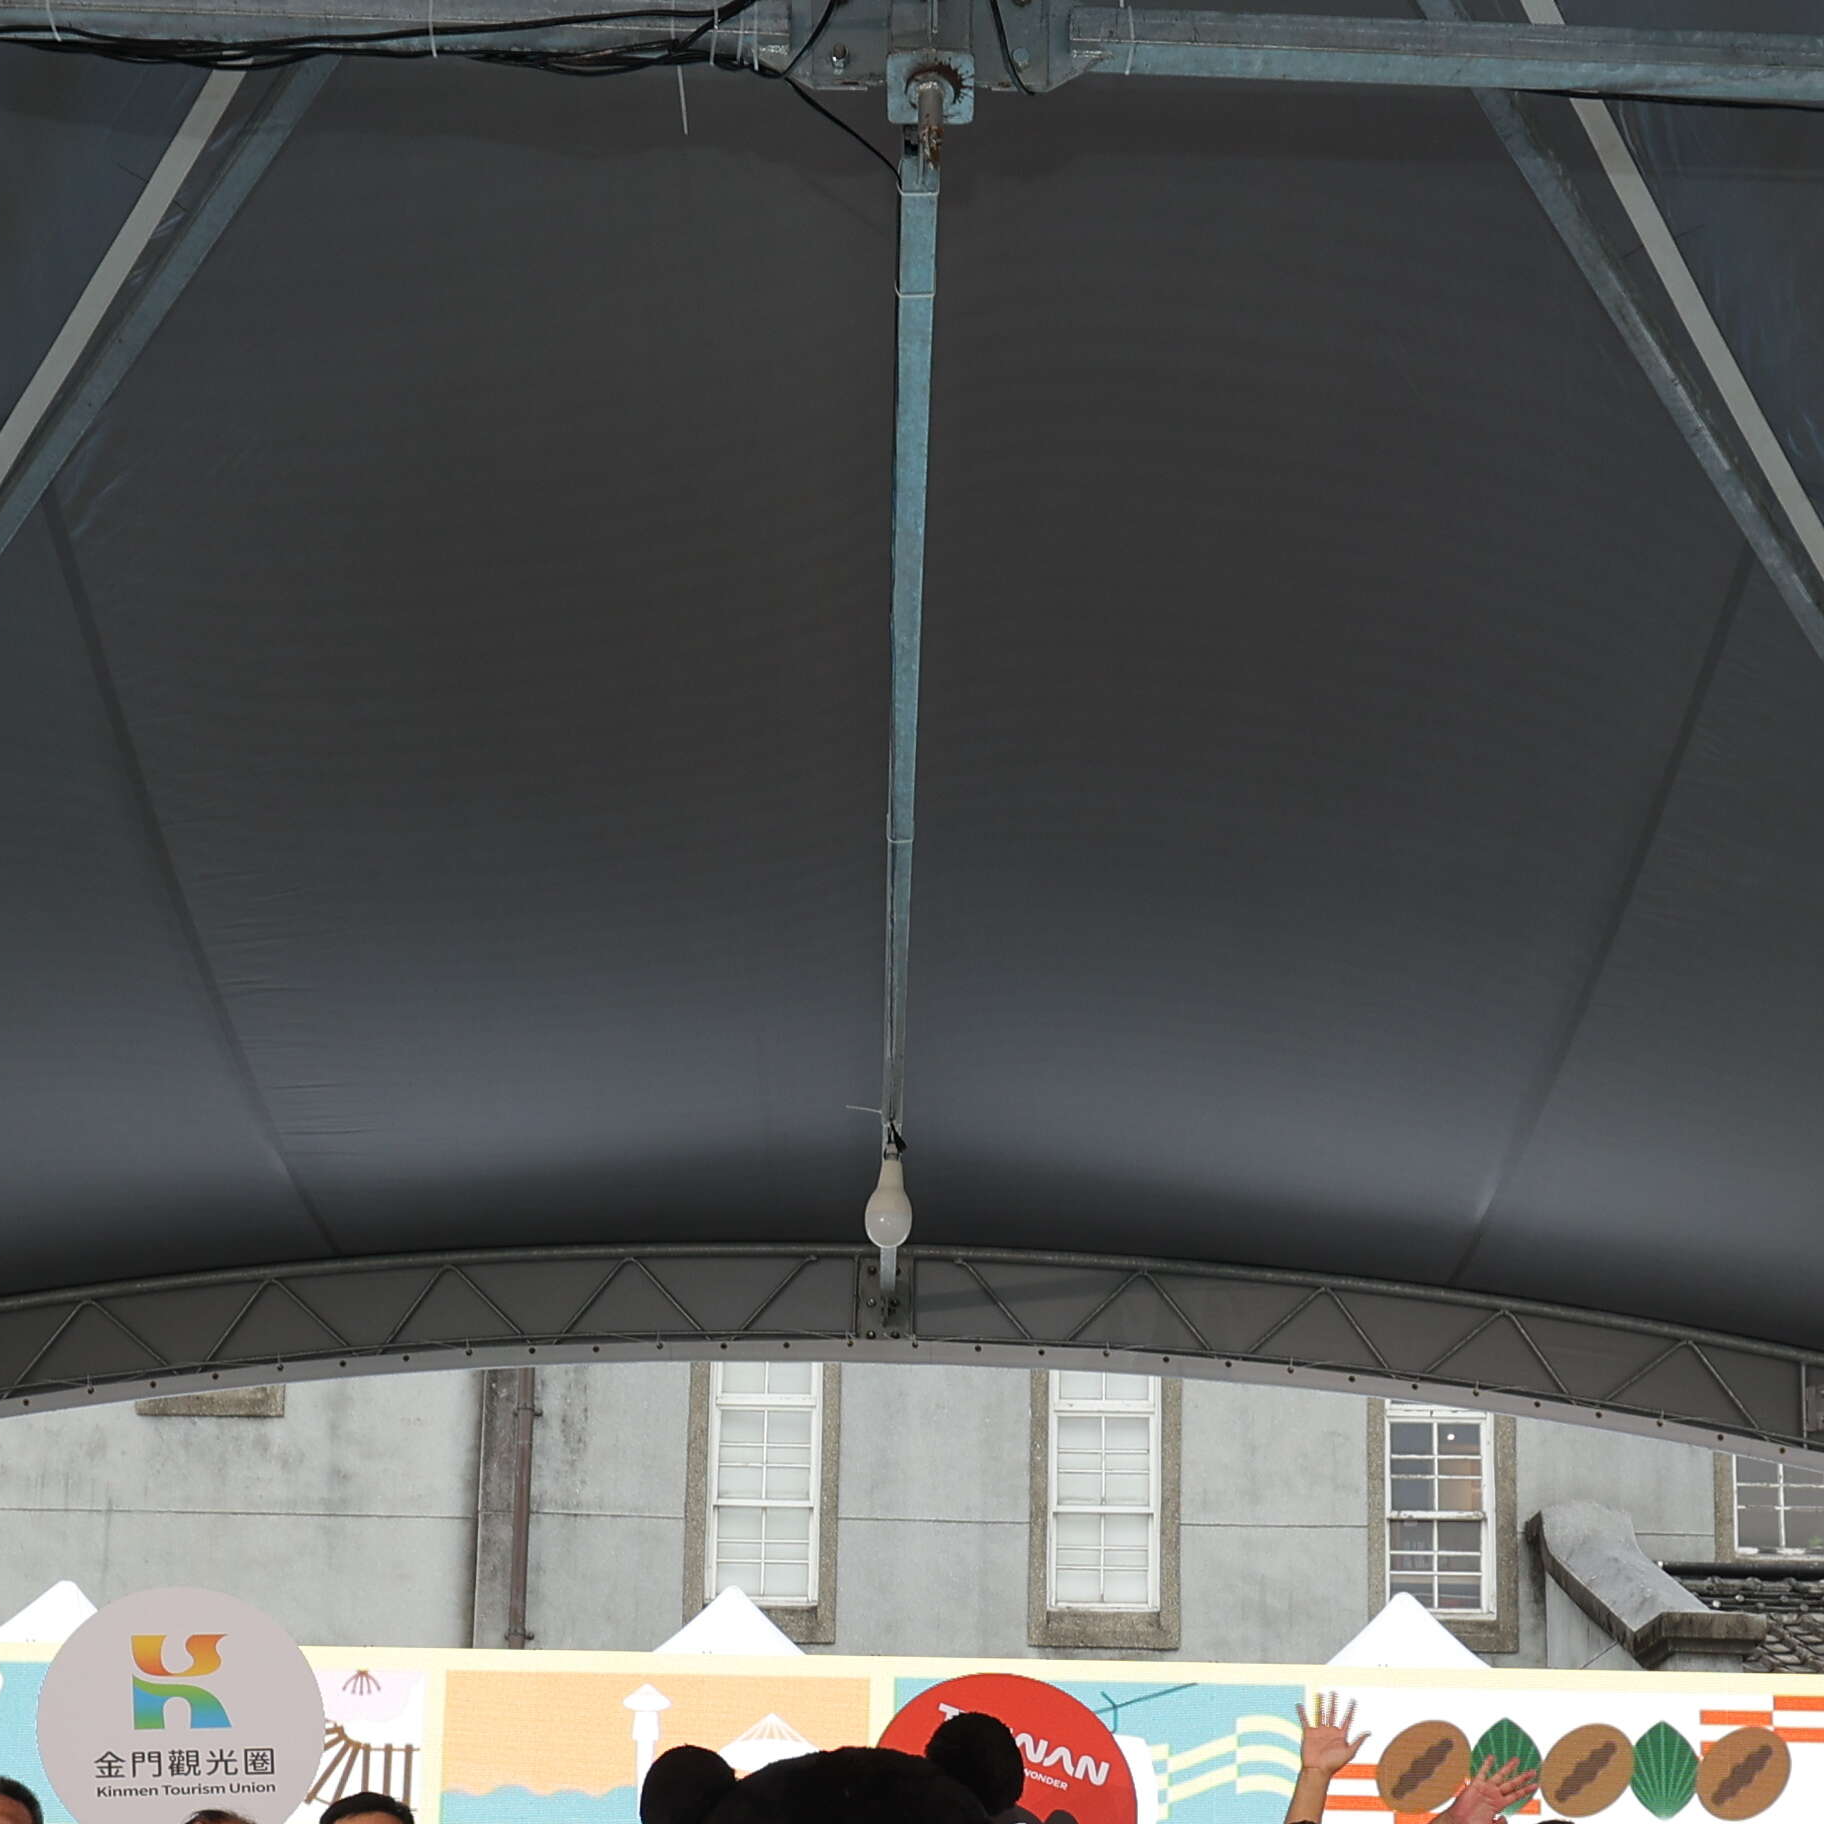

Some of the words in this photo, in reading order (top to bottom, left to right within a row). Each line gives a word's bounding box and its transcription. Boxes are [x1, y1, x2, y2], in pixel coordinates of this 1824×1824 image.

[94, 1748, 275, 1779] 金門觀光圈
[96, 1785, 159, 1798] Kinmen
[162, 1782, 226, 1796] Tourism
[229, 1781, 276, 1794] Union
